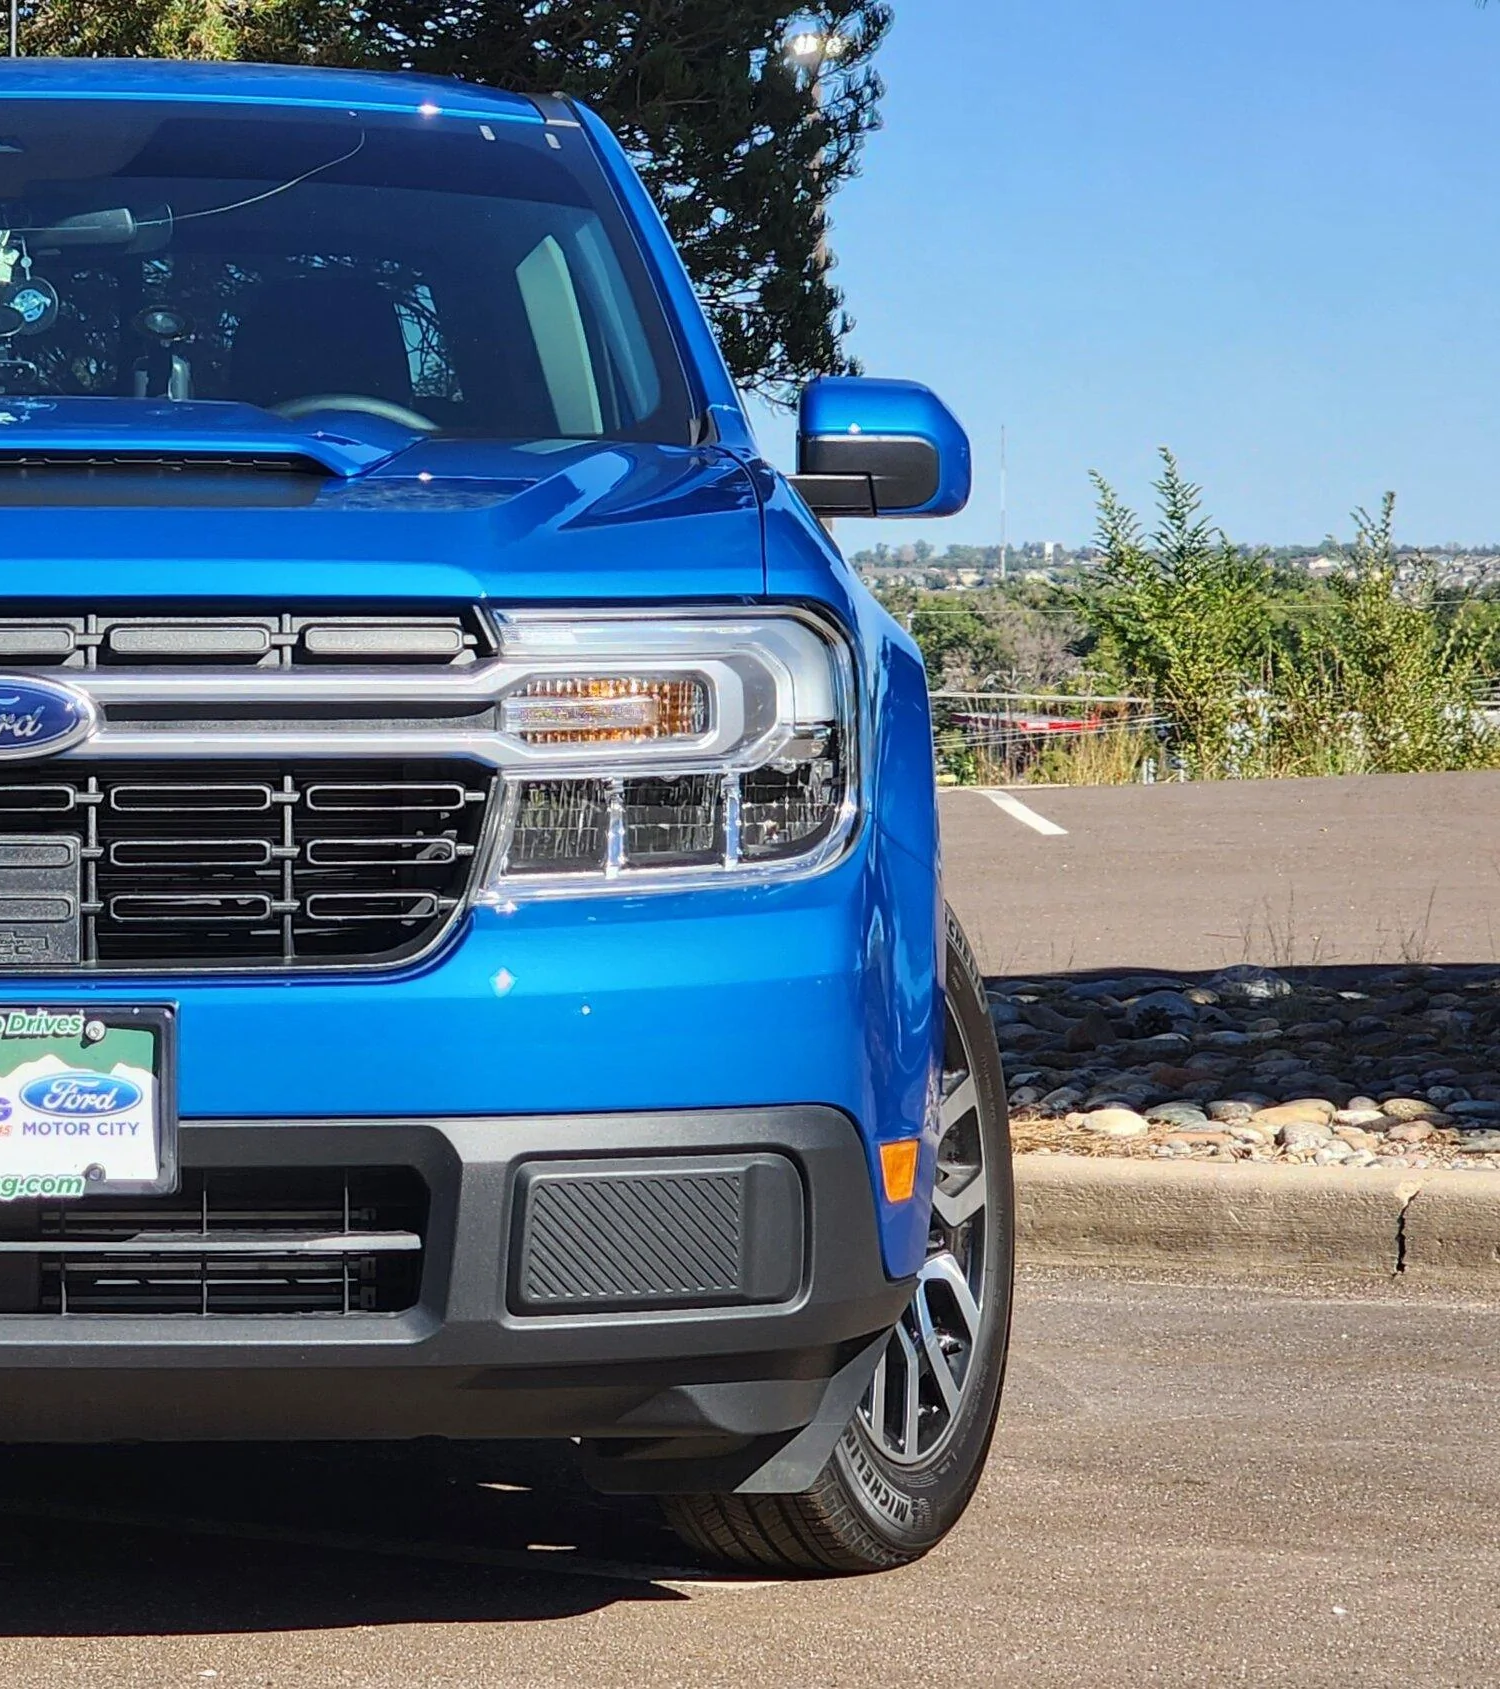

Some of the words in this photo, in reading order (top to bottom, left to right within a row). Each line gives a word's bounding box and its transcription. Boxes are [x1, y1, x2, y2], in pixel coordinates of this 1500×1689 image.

[7, 1011, 82, 1033] Drives
[42, 1079, 119, 1110] Ford
[22, 1122, 91, 1136] MOTOR
[96, 1122, 140, 1136] CITY
